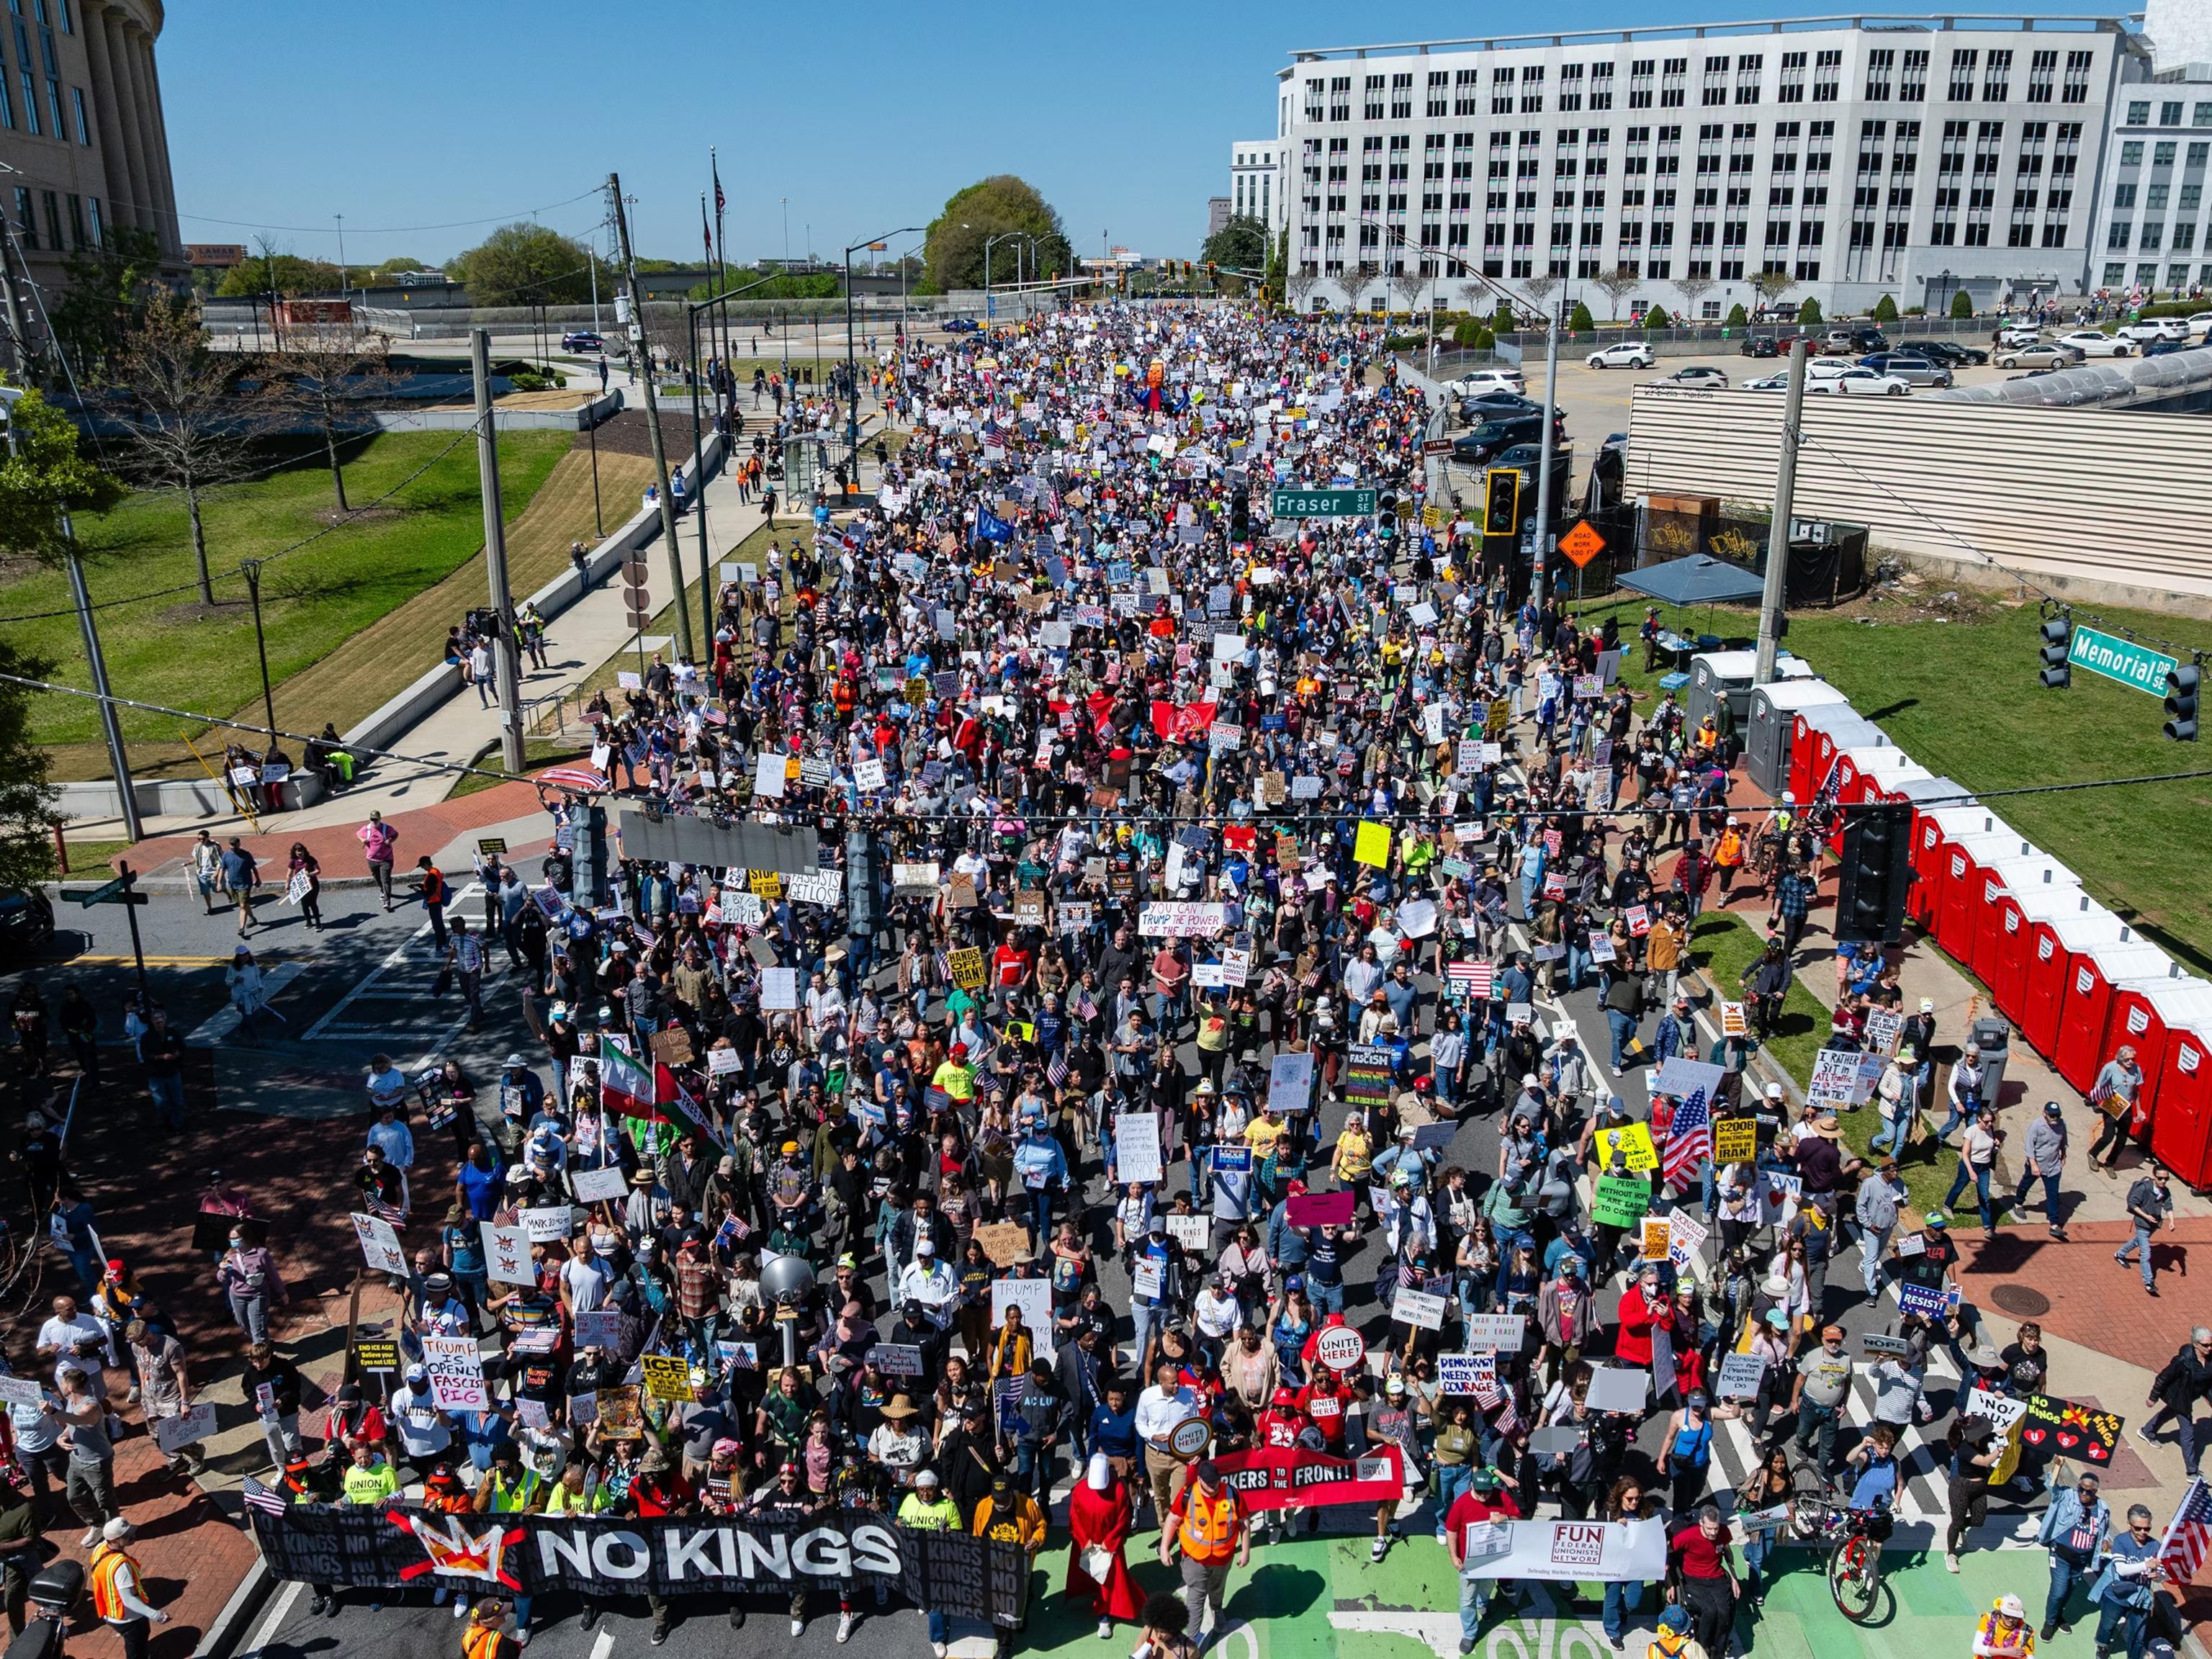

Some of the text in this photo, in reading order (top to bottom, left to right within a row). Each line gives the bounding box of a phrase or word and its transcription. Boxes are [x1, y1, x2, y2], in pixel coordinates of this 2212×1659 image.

[199, 246, 235, 256] LAMAR
[1277, 495, 1340, 513] Fraser
[1107, 564, 1130, 582] LOVE
[2074, 634, 2156, 683] Memorial
[2157, 660, 2171, 675] DR
[2153, 678, 2165, 691] SE
[1213, 727, 1241, 737] IMPEACH
[1268, 773, 1280, 782] NO
[1265, 781, 1282, 790] ONE
[751, 869, 775, 879] STOP
[792, 871, 841, 888] FASCISTS
[790, 883, 839, 904] GET LOST
[732, 894, 745, 906] BY
[1020, 904, 1038, 914] NO
[1150, 903, 1208, 914] YOU CAN'T
[722, 907, 757, 923] PEOPLE
[1015, 914, 1046, 925] KINGS
[1143, 914, 1220, 926] TRUMP THE POWER
[1147, 927, 1215, 937] OF THE PEOPLE
[948, 950, 979, 963] HANDS
[952, 960, 980, 971] OFF
[954, 968, 984, 984] IRAN!
[1349, 1054, 1388, 1066] FASCISM
[1831, 1053, 1860, 1066] RATHER
[1719, 1121, 1754, 1133] $200B
[1630, 1154, 1653, 1164] TREAD
[1719, 1148, 1751, 1159] IRAN!
[1136, 1162, 1159, 1179] YOU
[1617, 1180, 1640, 1189] PEOPLE
[1600, 1187, 1632, 1197] WITHOUT
[1607, 1196, 1622, 1205] ARE
[528, 1218, 547, 1228] MARK
[1674, 1212, 1706, 1238] DONALD
[986, 1230, 999, 1238] WE
[500, 1245, 513, 1254] NO
[984, 1237, 1017, 1250] PEOPLE
[503, 1267, 516, 1275] NO
[1427, 1277, 1450, 1287] ICE
[997, 1282, 1043, 1296] TRUMP
[1903, 1293, 1944, 1311] RESIST!
[424, 1340, 476, 1356] TRUMP
[1322, 1337, 1360, 1350] UNITE
[1863, 1339, 1905, 1349] NOPE
[443, 1354, 462, 1364] IS
[1323, 1347, 1359, 1360] HERE!
[643, 1357, 686, 1373] ICE
[1440, 1357, 1494, 1369] DEMOCRACY
[428, 1362, 482, 1377] OPENLY
[884, 1366, 917, 1375] Fascist
[433, 1375, 485, 1388] FASCIST
[526, 1375, 546, 1385] Trouble
[1441, 1370, 1496, 1382] NEEDS YOUR
[1443, 1381, 1493, 1393] COURAGE
[440, 1388, 480, 1403] PIG
[1024, 1395, 1053, 1407] ACLU
[2031, 1395, 2048, 1408] NO
[1312, 1398, 1337, 1408] UNITE
[1313, 1406, 1339, 1416] HERE!
[2028, 1405, 2061, 1425] KINGS
[2105, 1414, 2119, 1431] NO
[1178, 1429, 1204, 1441] UNITE
[2093, 1415, 2115, 1447] KINGS
[1178, 1435, 1204, 1447] HERE!
[1270, 1432, 1294, 1447] 23
[1276, 1467, 1286, 1477] TO
[1295, 1465, 1351, 1486] FRONT!
[350, 1479, 382, 1490] UNION
[1274, 1479, 1287, 1488] THE
[910, 1515, 944, 1526] UNION
[1556, 1527, 1602, 1543] FUN
[288, 1533, 369, 1553] KINGS NO
[536, 1525, 902, 1580] NO KINGS
[927, 1540, 1017, 1572] KINGS NO
[928, 1564, 1017, 1593] KINGS NO
[991, 1594, 1017, 1615] NO
